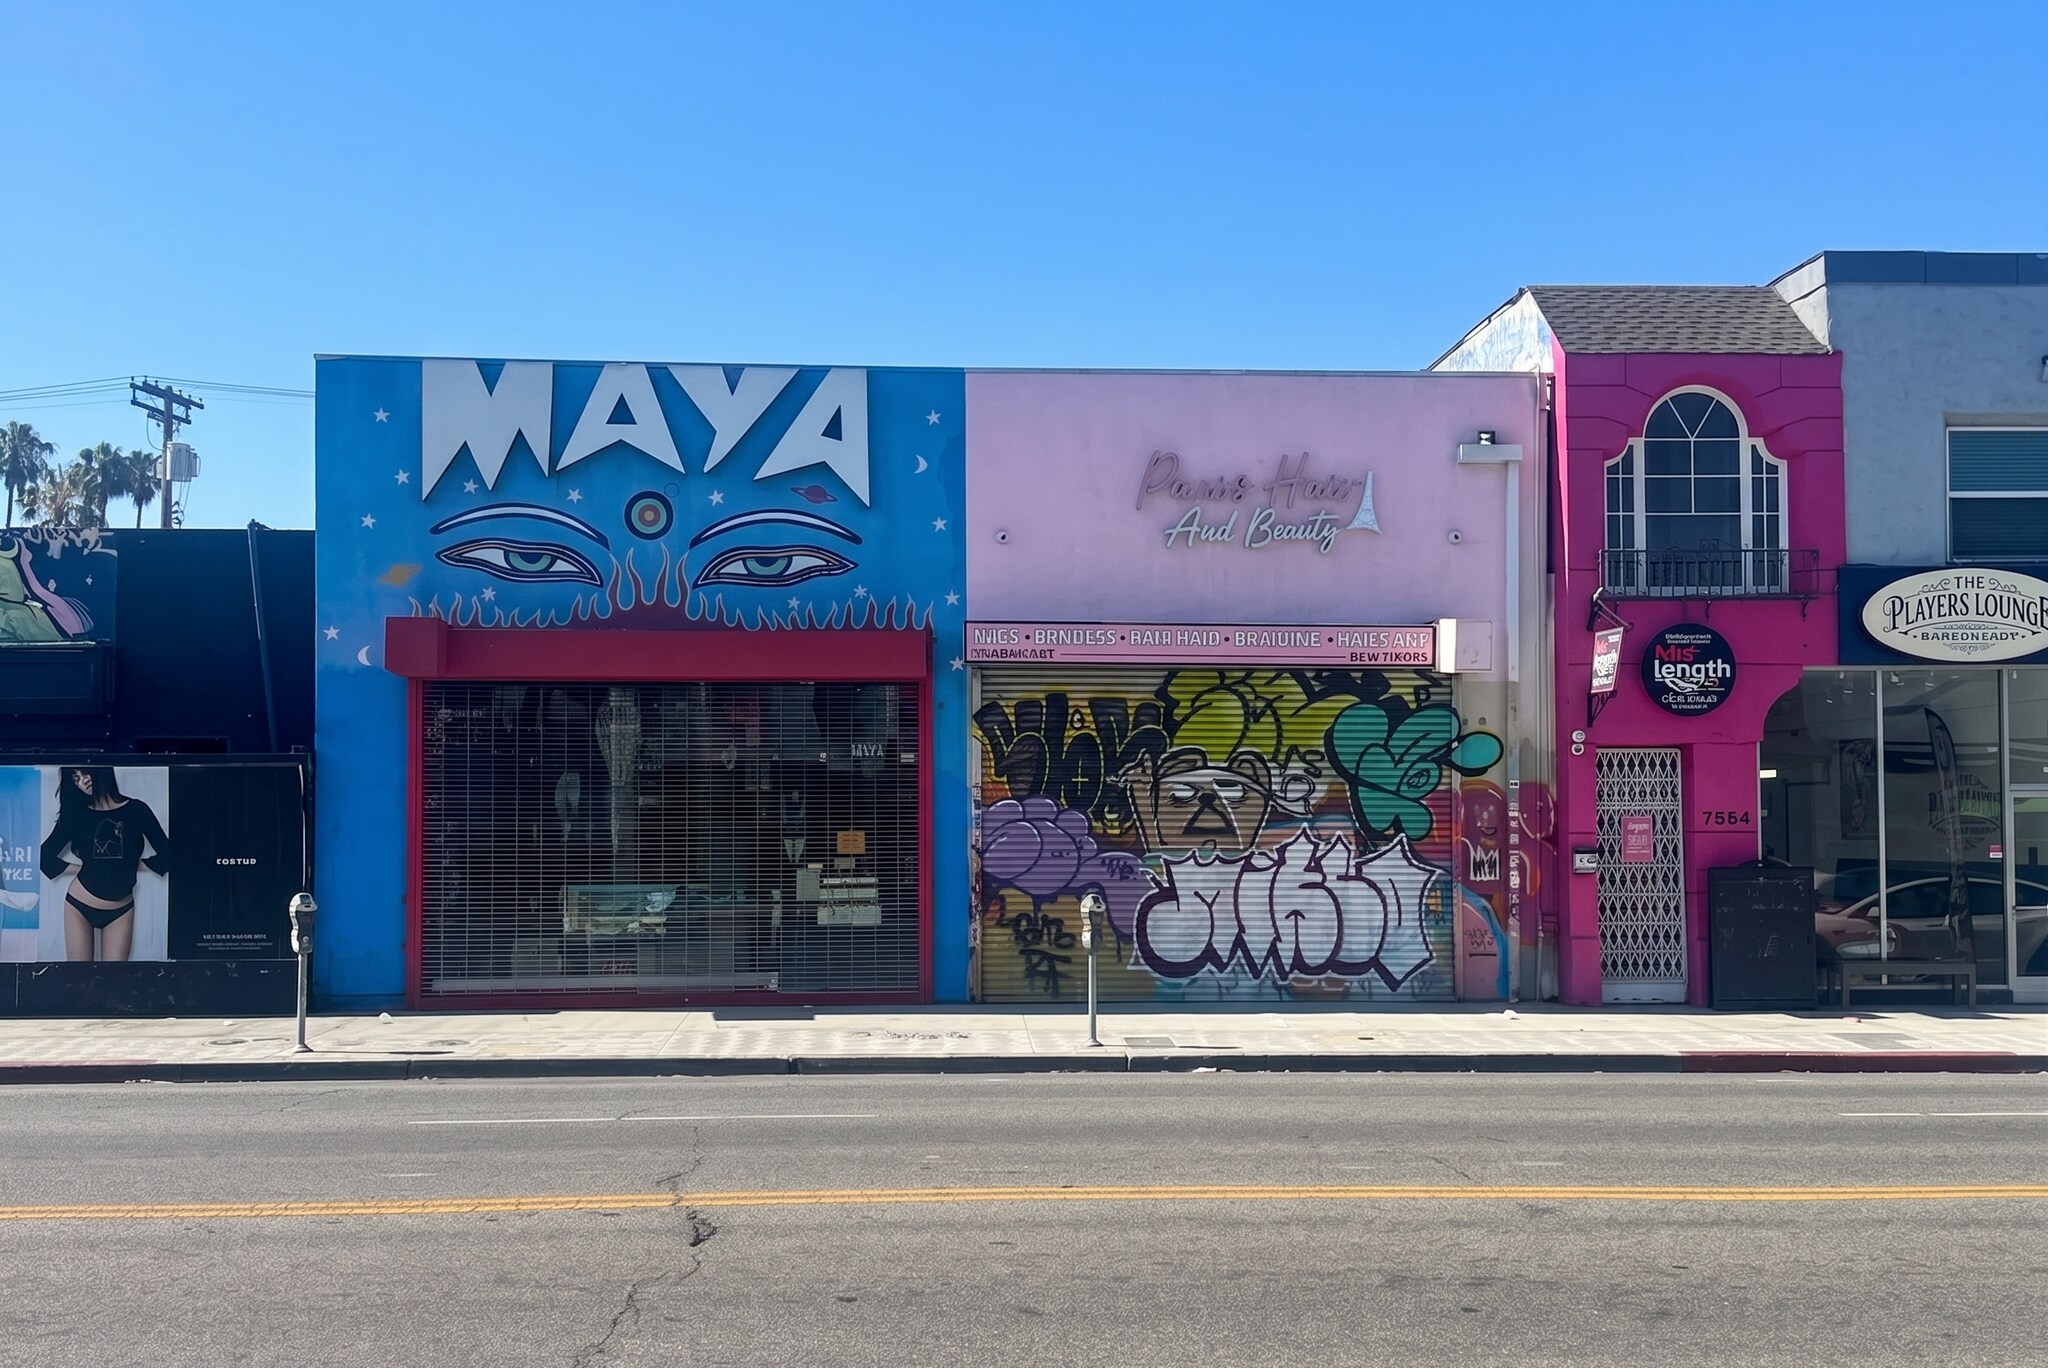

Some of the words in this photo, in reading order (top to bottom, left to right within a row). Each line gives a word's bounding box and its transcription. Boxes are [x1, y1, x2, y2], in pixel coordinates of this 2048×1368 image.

[422, 359, 870, 508] MAYA
[1136, 450, 1253, 511] Paris
[1263, 452, 1361, 509] Hair
[1165, 506, 1239, 548] And
[1244, 507, 1349, 554] Beauty
[1953, 576, 1985, 589] THE
[1882, 595, 1969, 633] PLAYERS
[1975, 593, 2048, 631] LOUNGE
[1350, 652, 1380, 662] BEW
[1654, 659, 1731, 684] length
